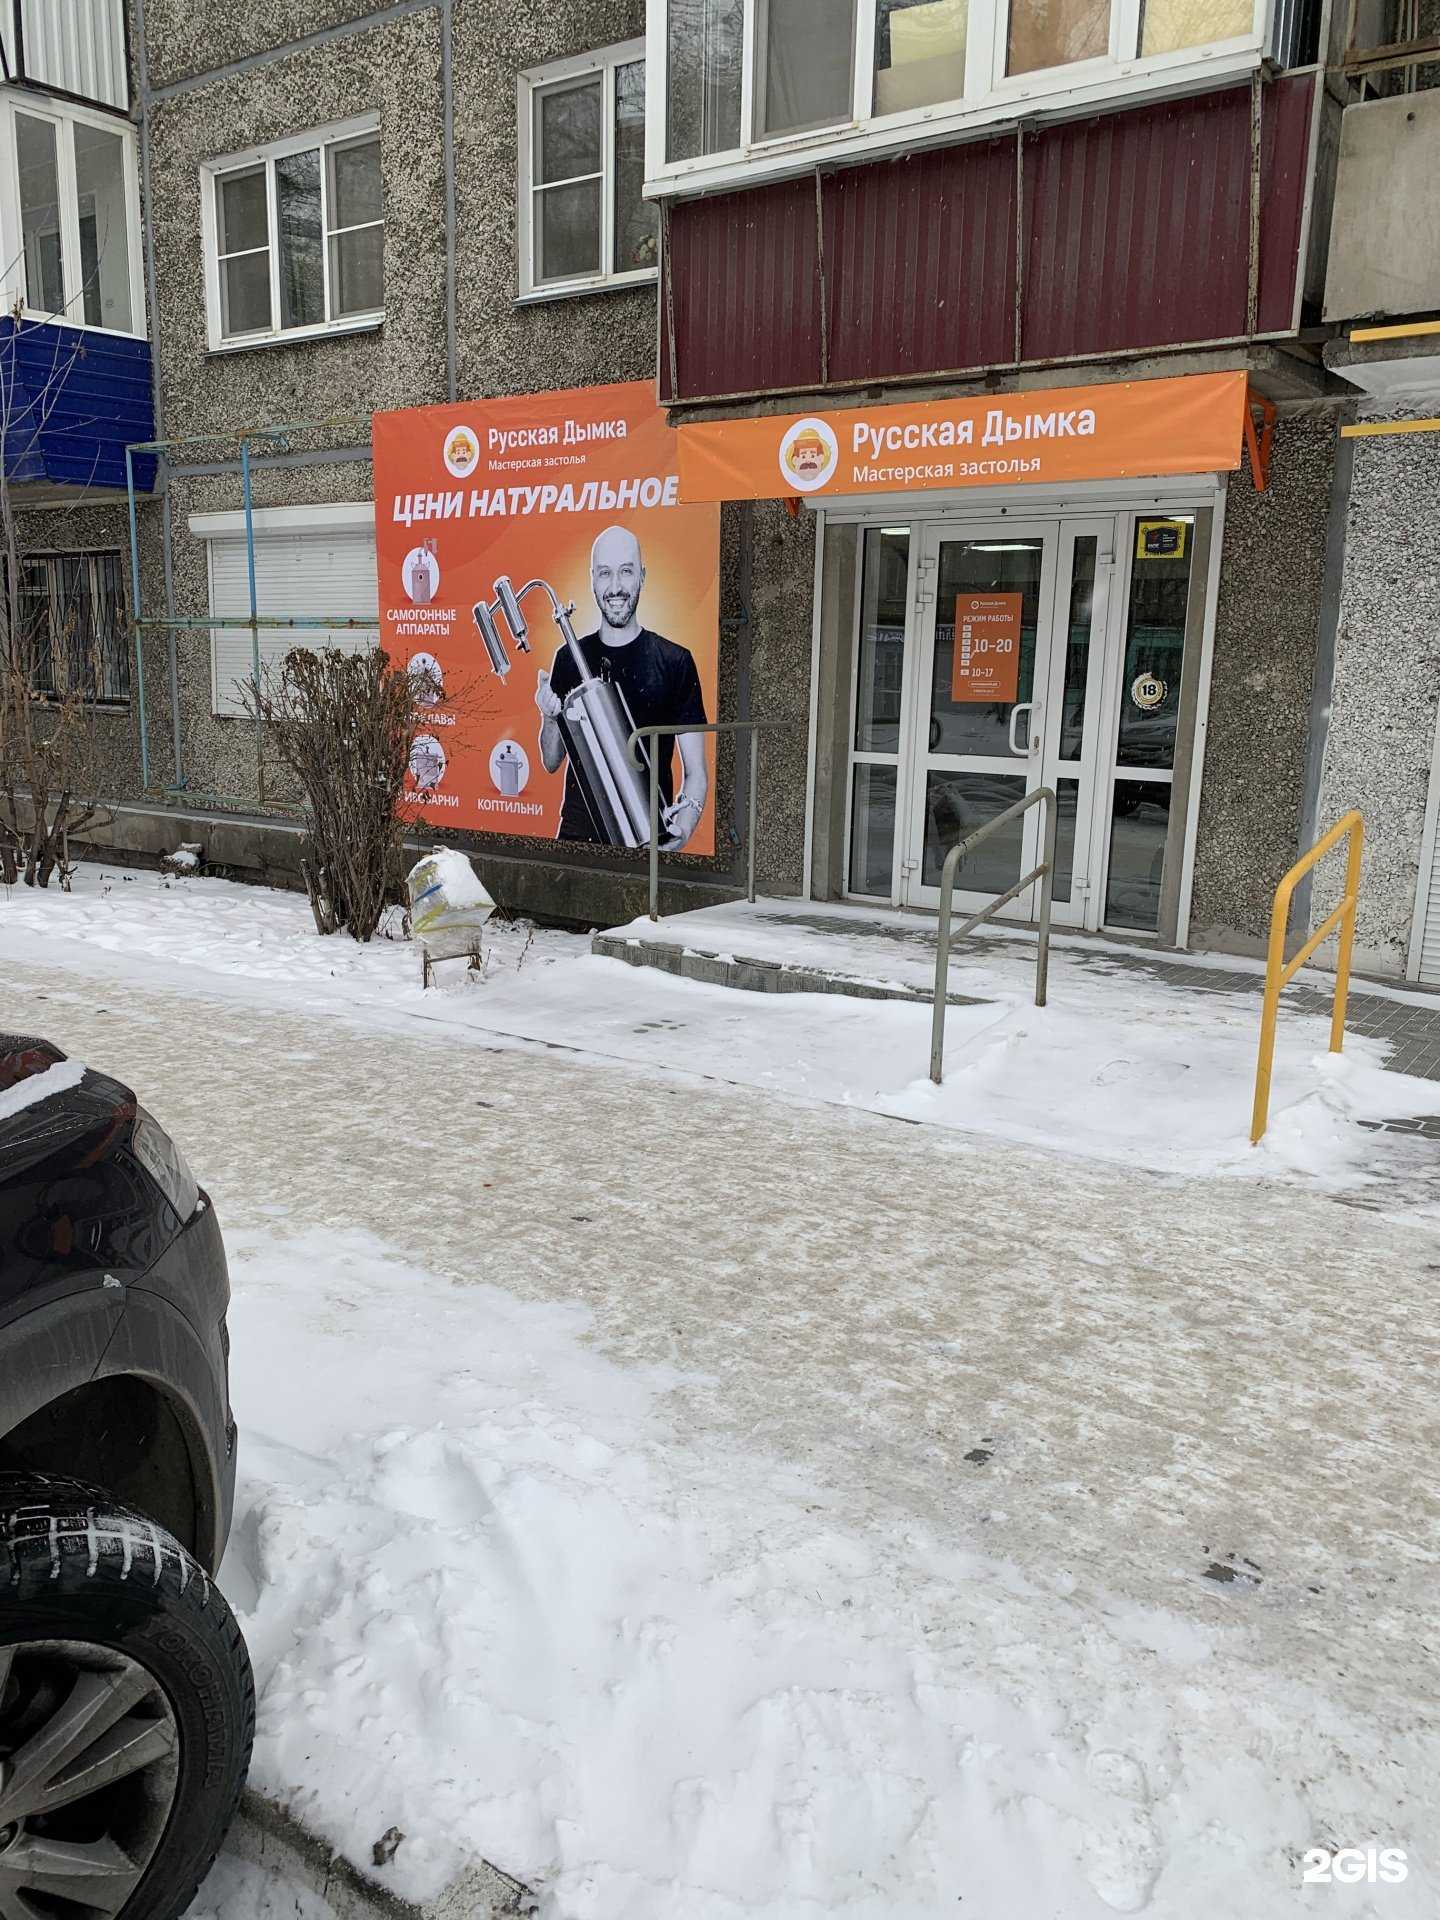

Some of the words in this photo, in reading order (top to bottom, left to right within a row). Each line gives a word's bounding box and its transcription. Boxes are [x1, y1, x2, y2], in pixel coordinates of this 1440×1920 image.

[488, 424, 558, 455] Русская
[563, 418, 627, 445] Дымка
[852, 418, 972, 459] Русская
[982, 407, 1096, 446] Дымка
[488, 456, 542, 474] Мастерская
[544, 454, 586, 469] застолья
[852, 461, 954, 485] Мастерская
[959, 455, 1041, 476] застолья
[393, 489, 463, 527] ЦЕНИ
[469, 475, 680, 517] НАТУРАЛЬНОЕ
[386, 608, 457, 622] САМОГОННЫЕ
[962, 615, 986, 623] РЕЖИМ
[396, 623, 450, 636] АППАРАТЫ
[1141, 684, 1157, 697] 18
[477, 798, 543, 816] КОПТИЛЬНИ
